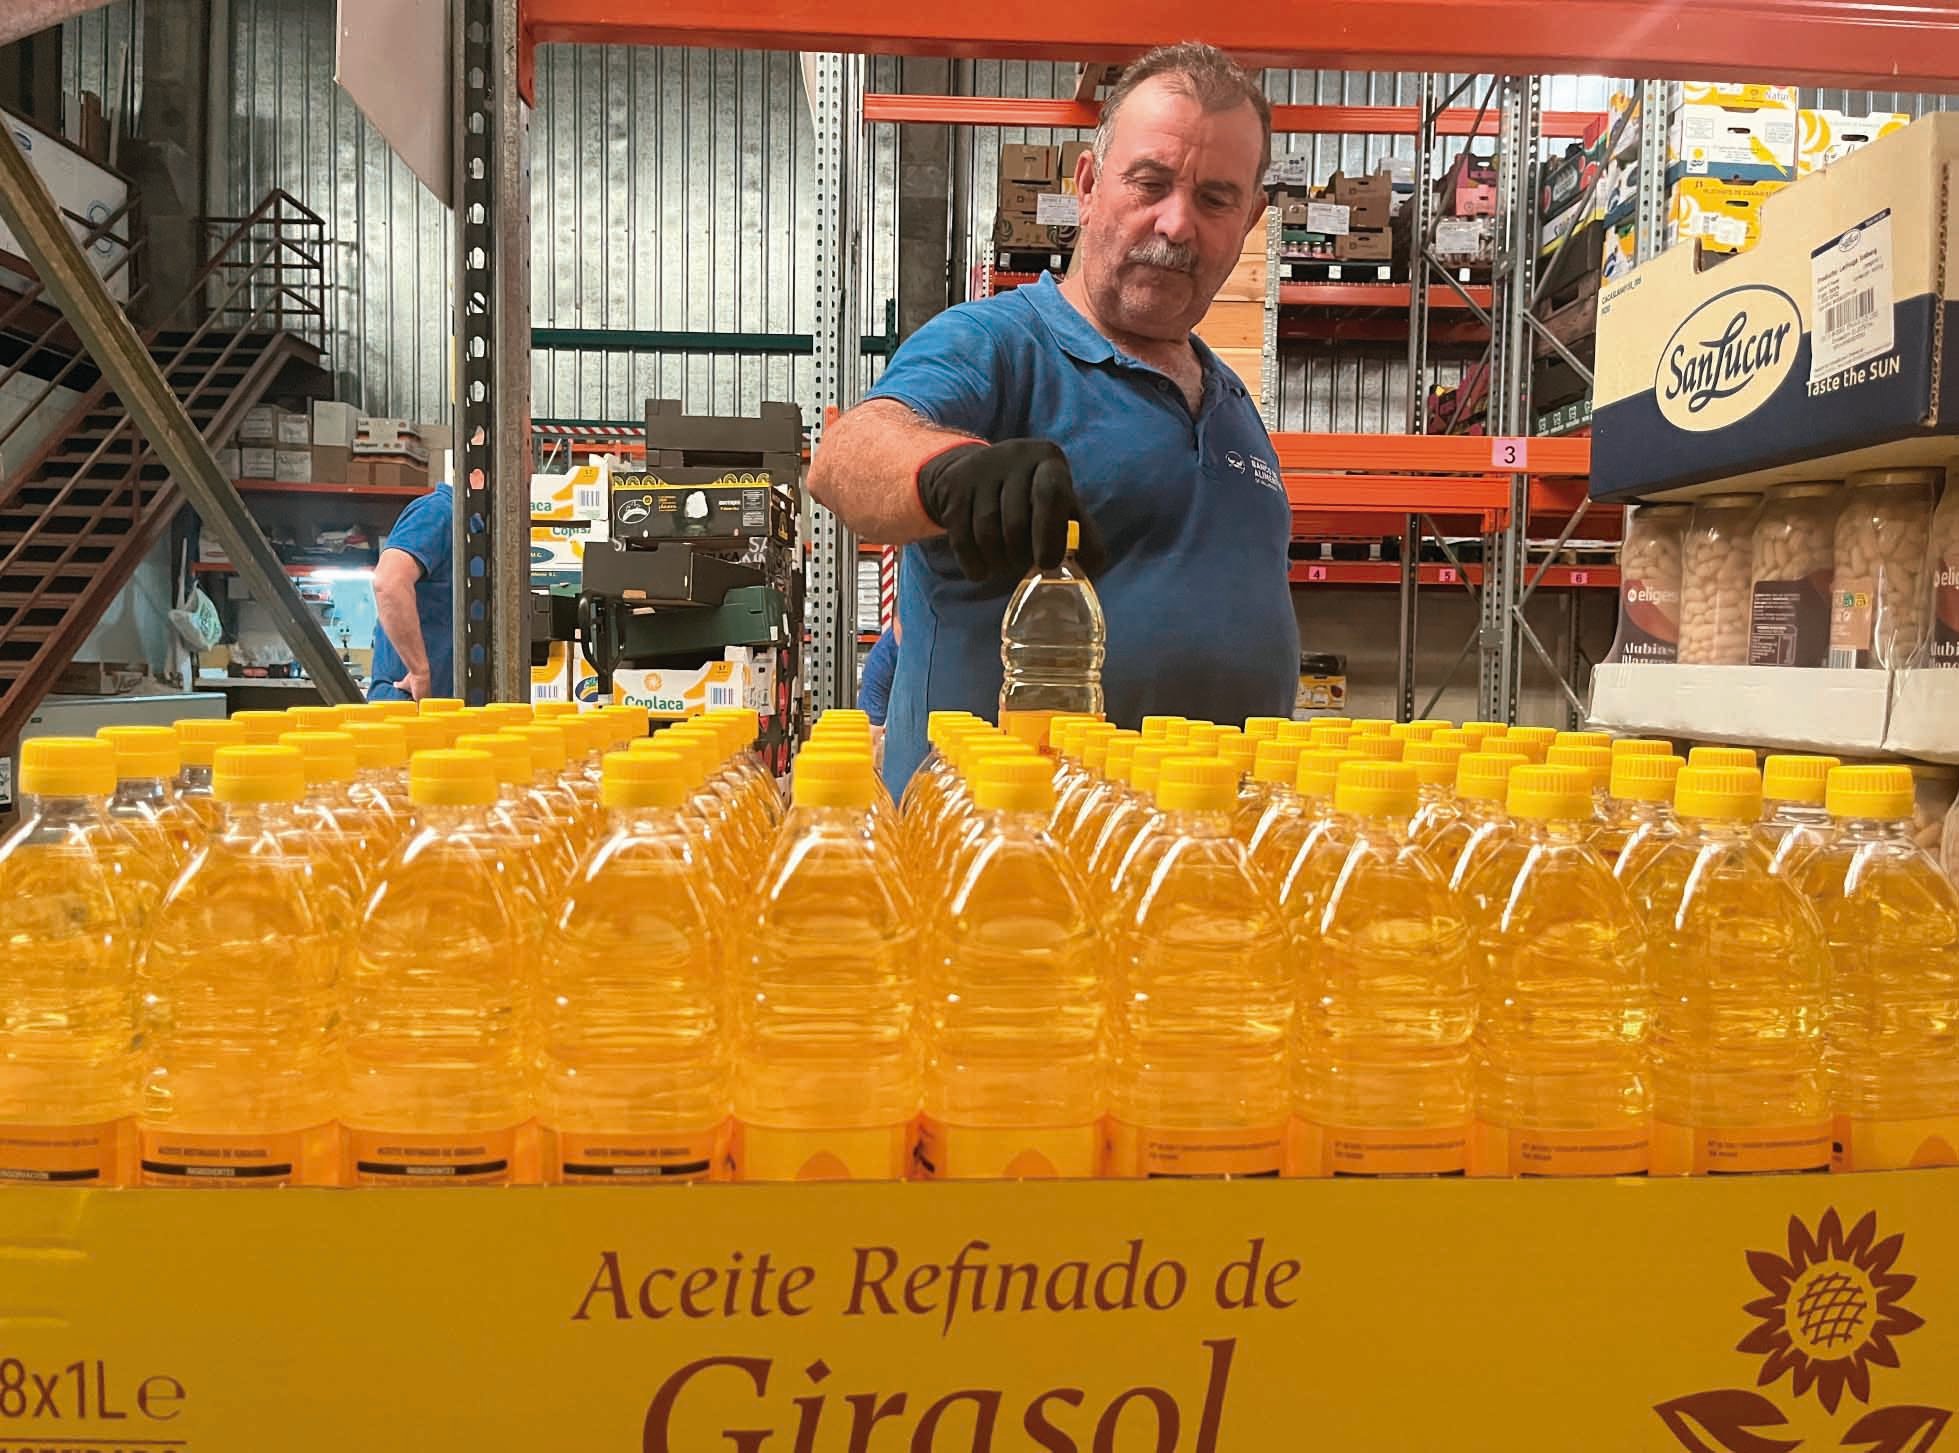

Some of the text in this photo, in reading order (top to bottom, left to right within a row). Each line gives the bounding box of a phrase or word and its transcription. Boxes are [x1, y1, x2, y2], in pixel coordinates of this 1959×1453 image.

[1805, 373, 1840, 398] Taste
[1843, 366, 1866, 387] the
[1869, 355, 1900, 380] SUN
[1504, 445, 1516, 464] 3
[1312, 568, 1321, 580] 4
[570, 1237, 1302, 1338] Aceite Refinado de
[643, 1336, 1237, 1453] Girasol
